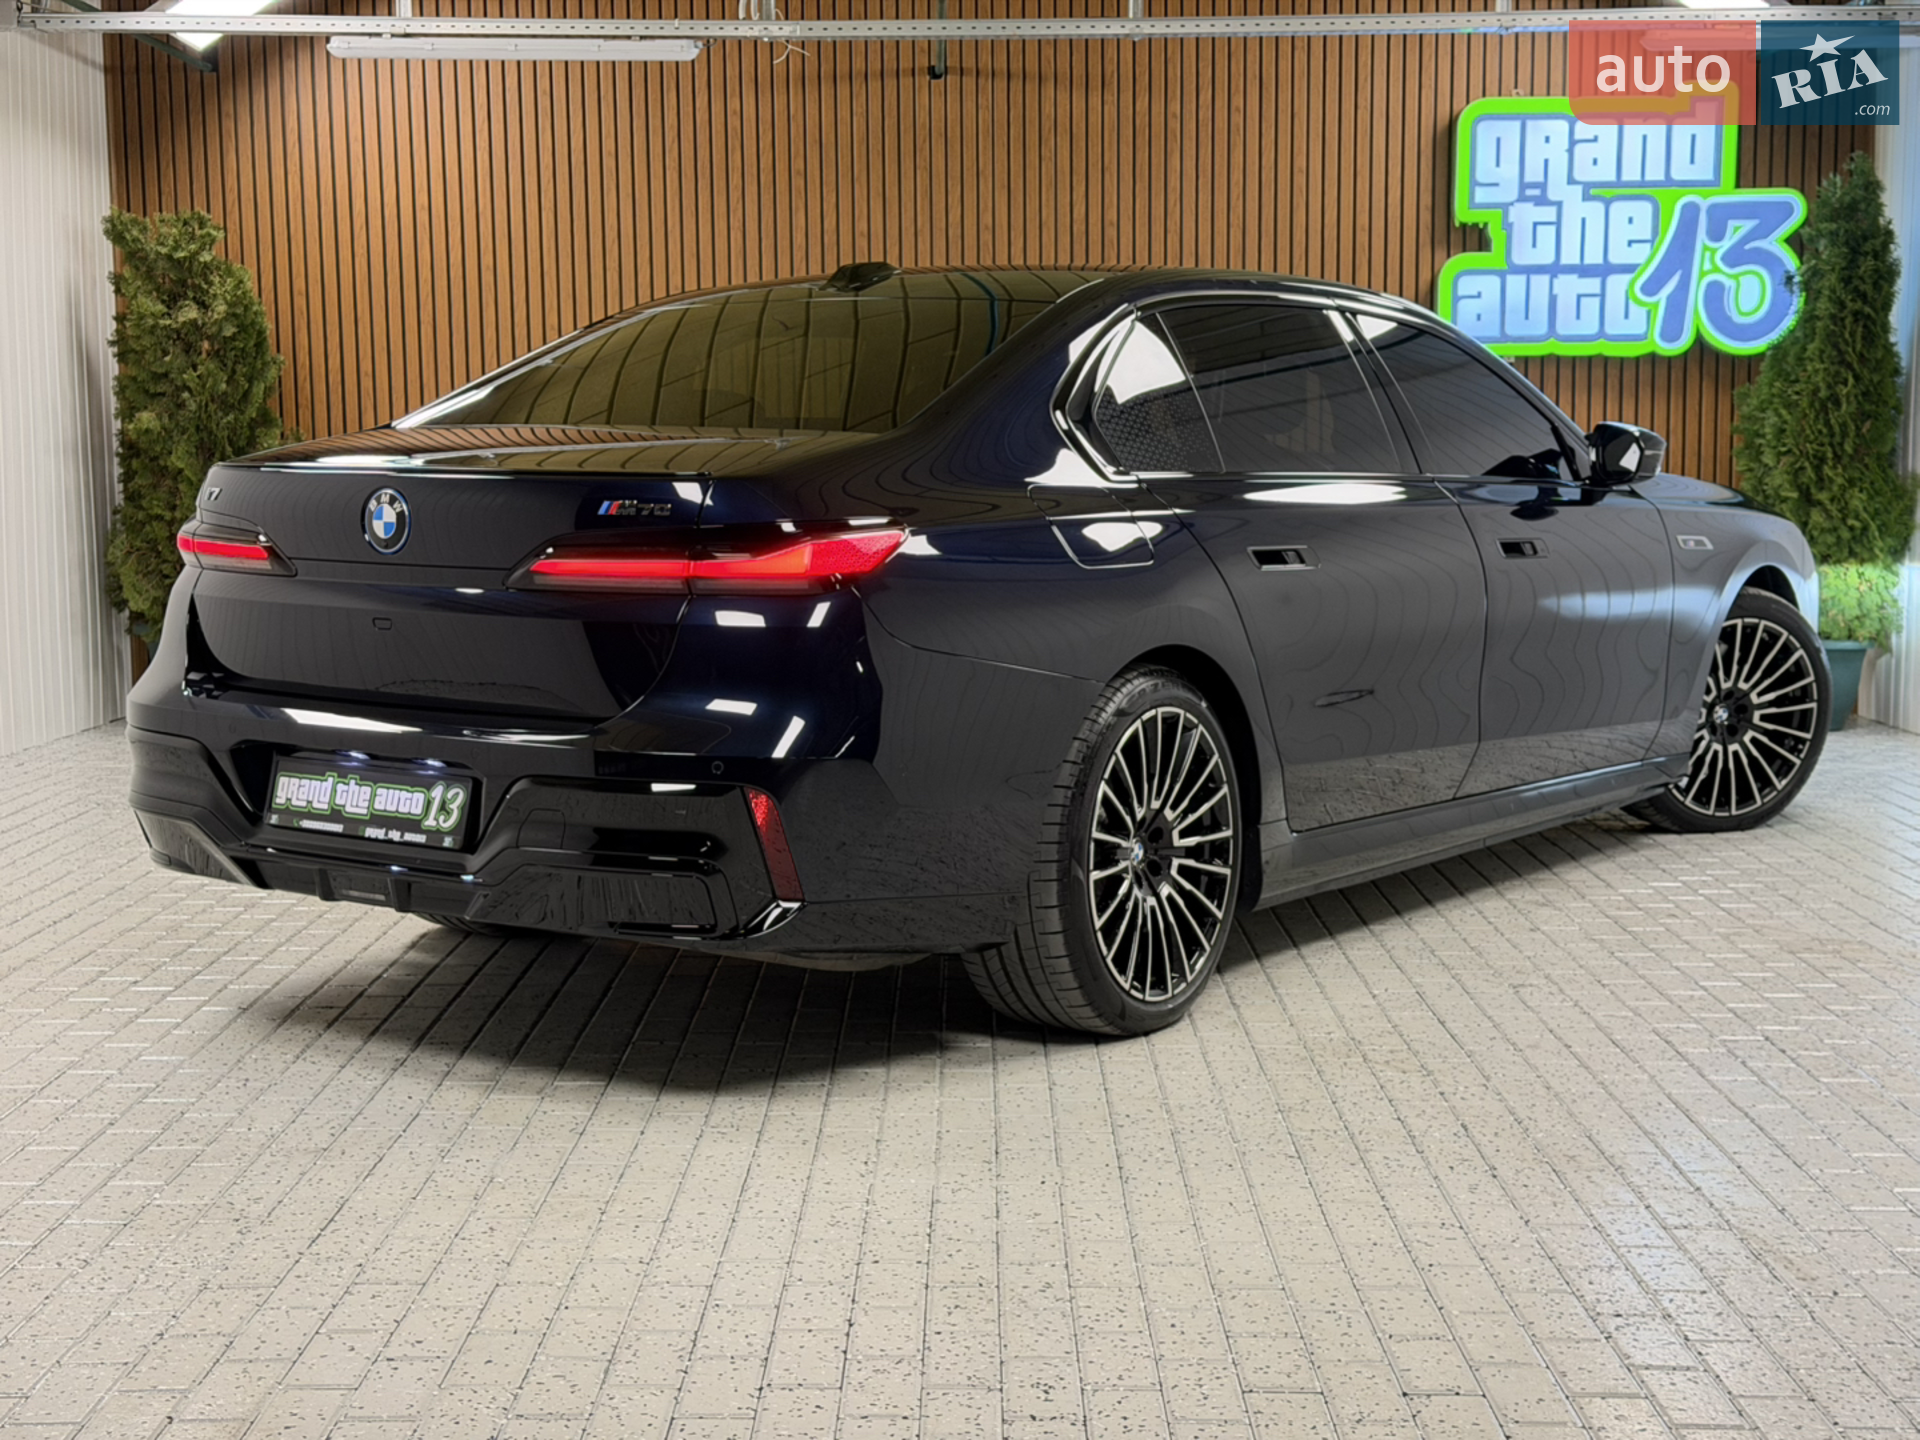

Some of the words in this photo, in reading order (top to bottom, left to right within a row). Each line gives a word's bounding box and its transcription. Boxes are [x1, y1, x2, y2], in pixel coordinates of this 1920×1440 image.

[1507, 196, 1653, 266] the
[1455, 273, 1650, 338] auto
[1634, 195, 1802, 349] 13
[369, 493, 404, 513] BMW
[275, 775, 334, 810] grand
[335, 779, 372, 815] the
[373, 787, 426, 816] auto
[424, 784, 465, 829] 13
